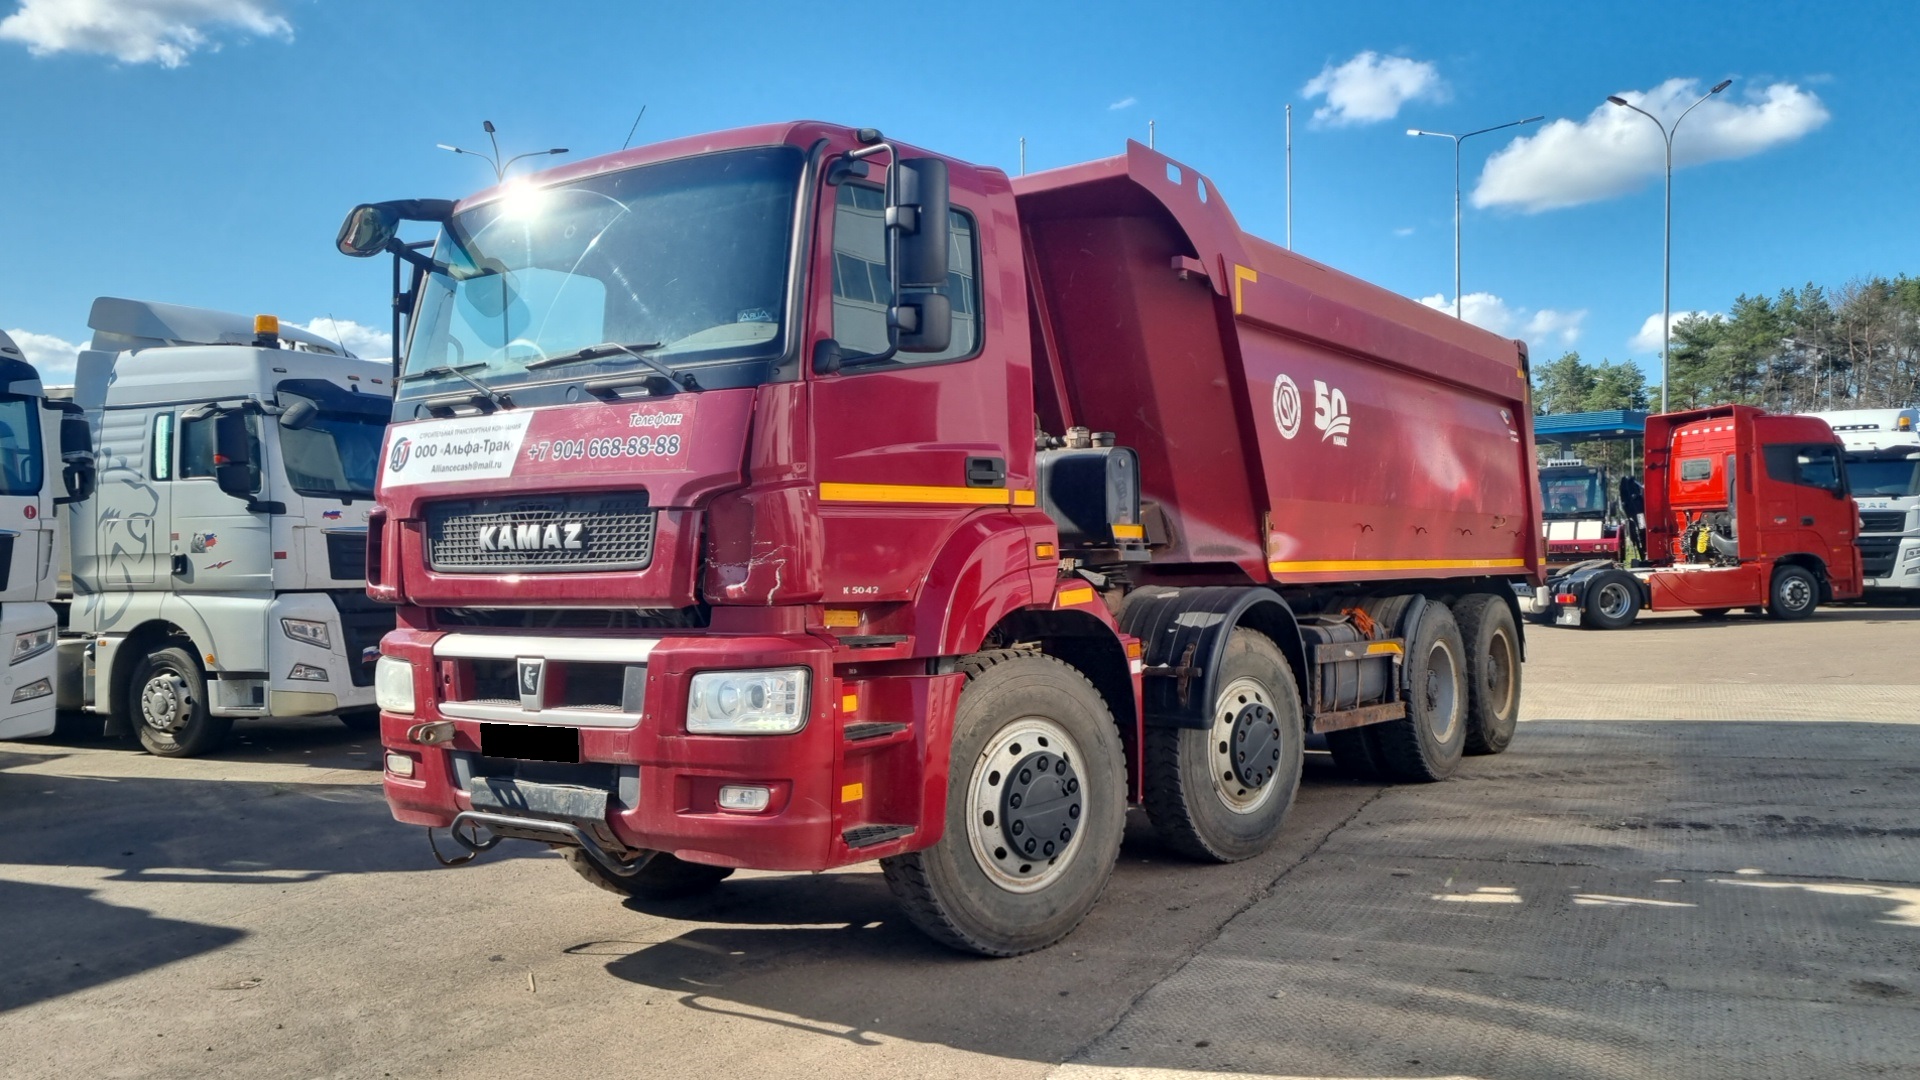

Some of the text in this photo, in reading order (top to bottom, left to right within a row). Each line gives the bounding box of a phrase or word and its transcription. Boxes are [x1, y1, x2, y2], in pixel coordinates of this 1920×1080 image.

[1314, 380, 1347, 430] 50
[630, 412, 683, 428] Телефон:
[455, 425, 491, 436] ТРАНСПОРТНАЯ
[415, 444, 437, 458] ООО
[528, 435, 680, 461] +7 904 668-88-88
[431, 460, 502, 473] Alliancecash@mail.ru
[480, 523, 582, 551] KAMAZ
[843, 586, 879, 595] K 5042
